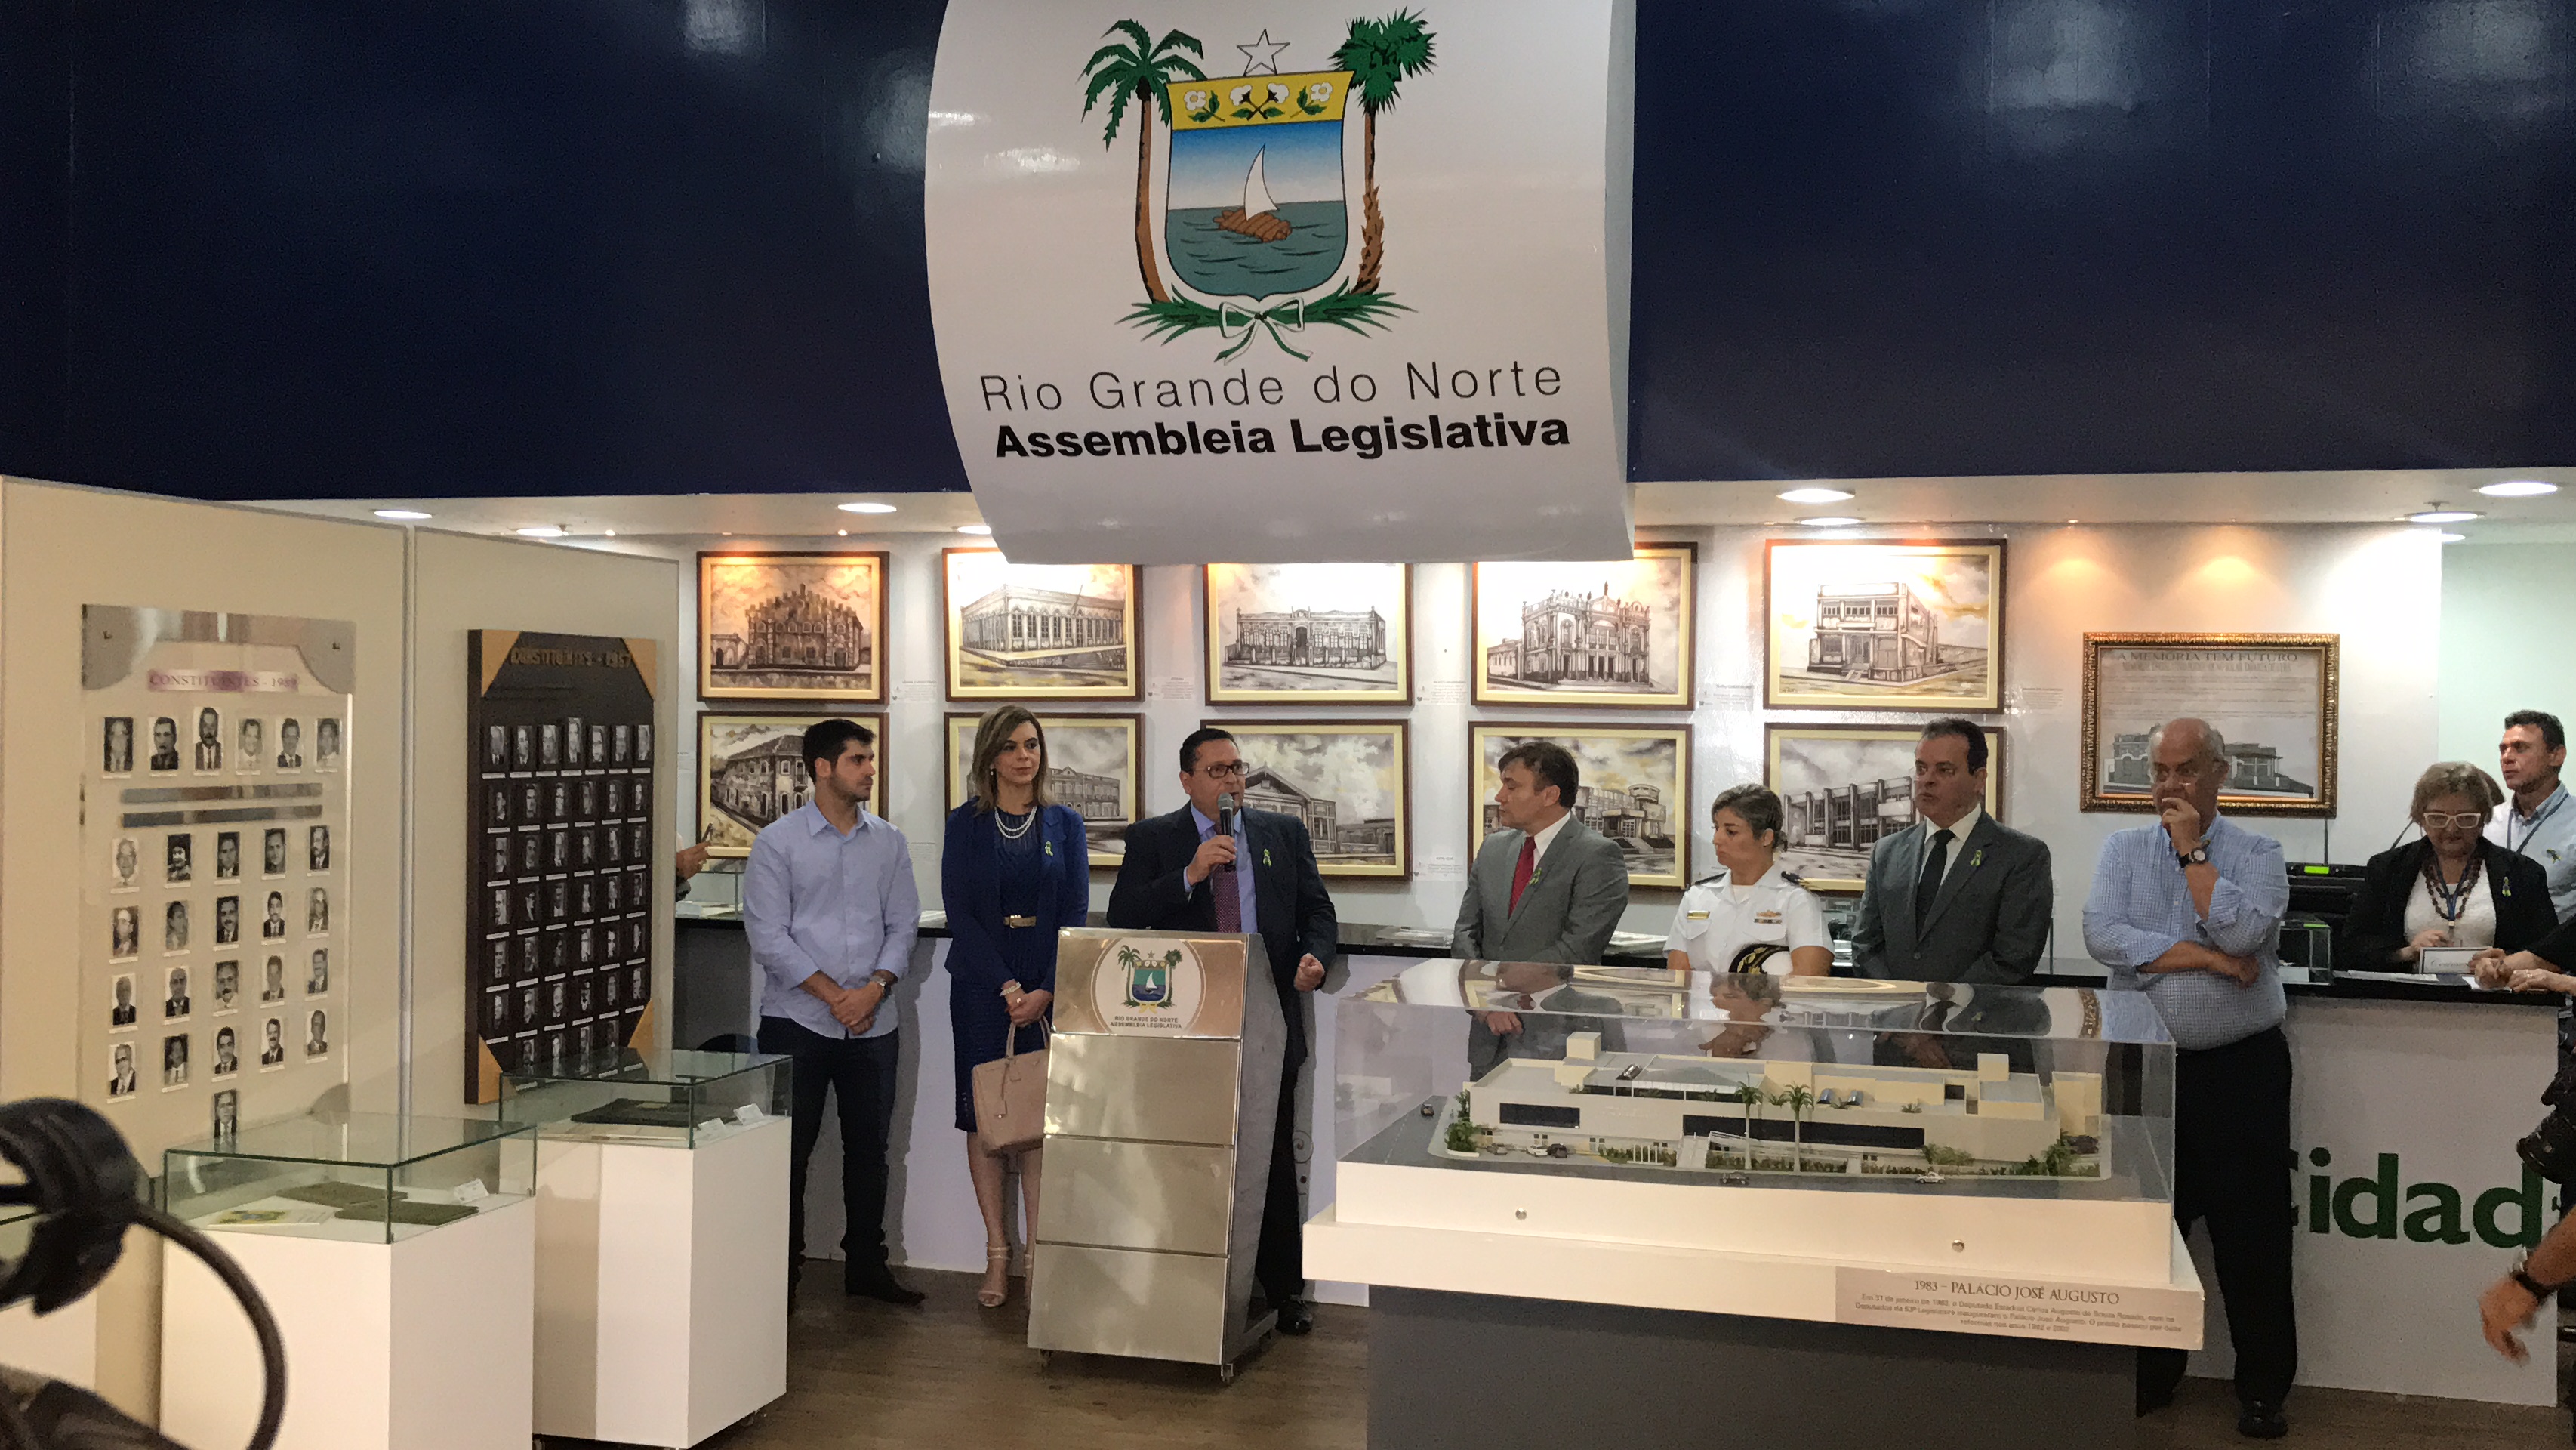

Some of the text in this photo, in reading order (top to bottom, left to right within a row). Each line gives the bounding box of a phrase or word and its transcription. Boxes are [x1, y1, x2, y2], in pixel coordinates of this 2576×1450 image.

[981, 361, 1561, 411] Rio Grande do Norte
[996, 412, 1570, 459] Assembleia Legislativa
[2206, 652, 2234, 661] TEM
[2239, 652, 2297, 662] FUTURO
[2291, 1147, 2560, 1248] idad
[1915, 1280, 1939, 1291] 1983
[1951, 1282, 2011, 1297] PALÁCIO
[2015, 1285, 2045, 1300] JOSÉ
[2050, 1289, 2119, 1305] AUGUSTO
